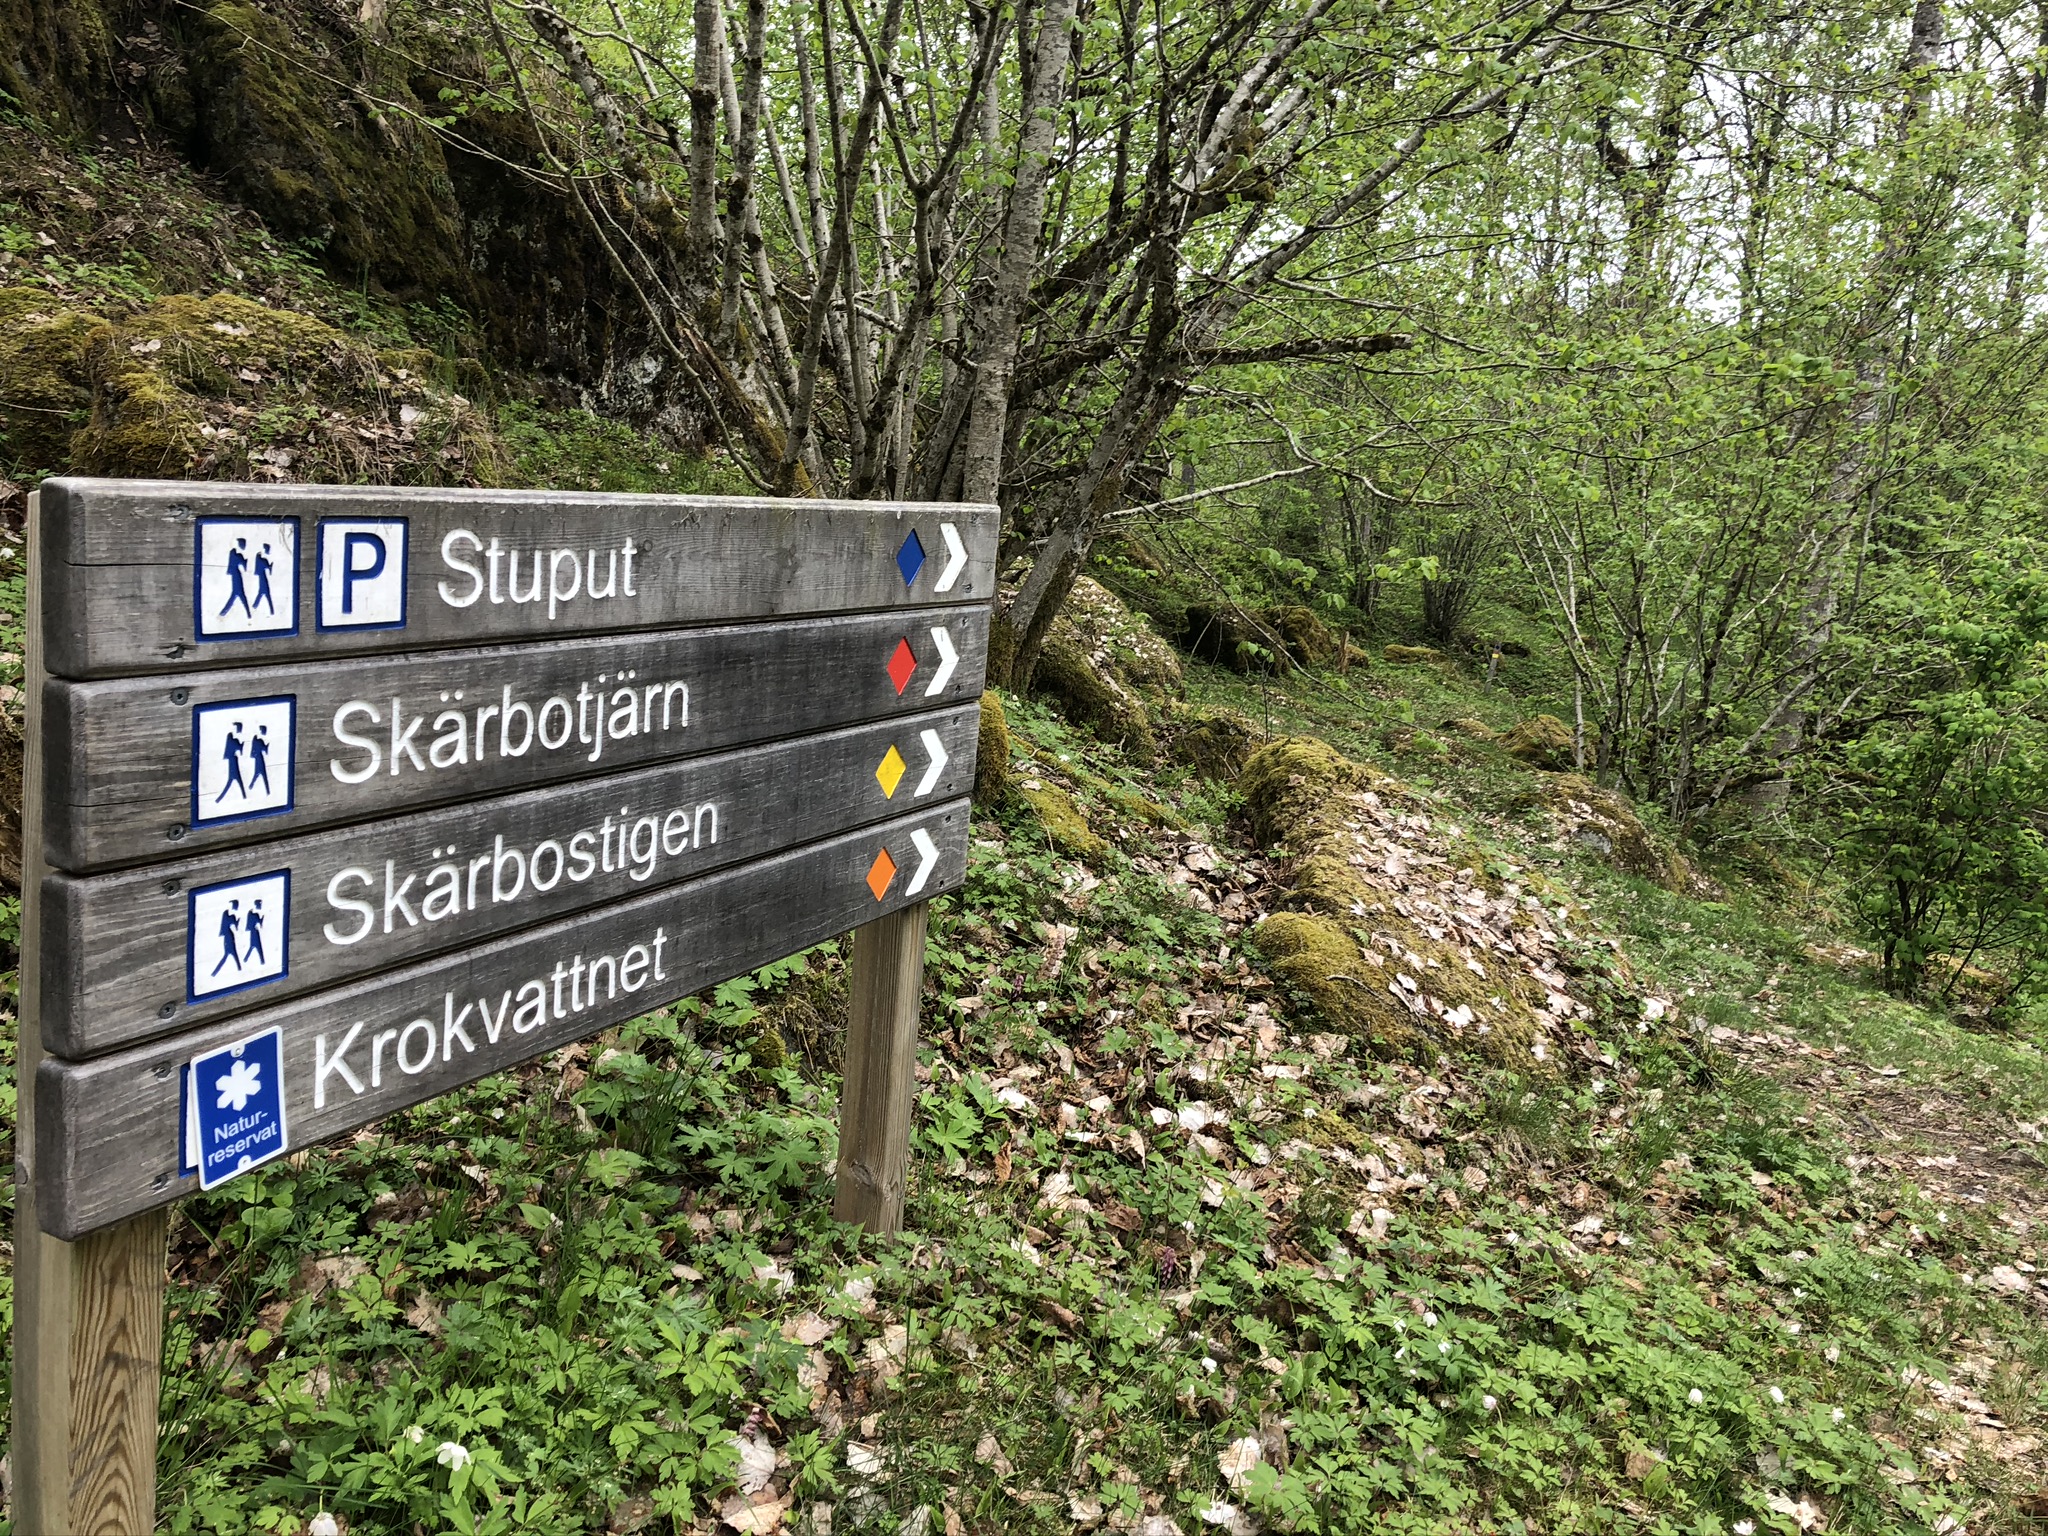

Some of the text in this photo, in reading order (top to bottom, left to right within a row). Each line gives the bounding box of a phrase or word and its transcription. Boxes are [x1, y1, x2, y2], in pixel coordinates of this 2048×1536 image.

[343, 530, 386, 614] P
[437, 528, 638, 620] Stuput
[330, 671, 690, 786] Skärbotjärn
[323, 801, 719, 946] Skärbostigen
[314, 928, 666, 1110] Krokvattnet
[207, 1121, 278, 1167] reservat
[213, 1111, 268, 1144] Natur-
